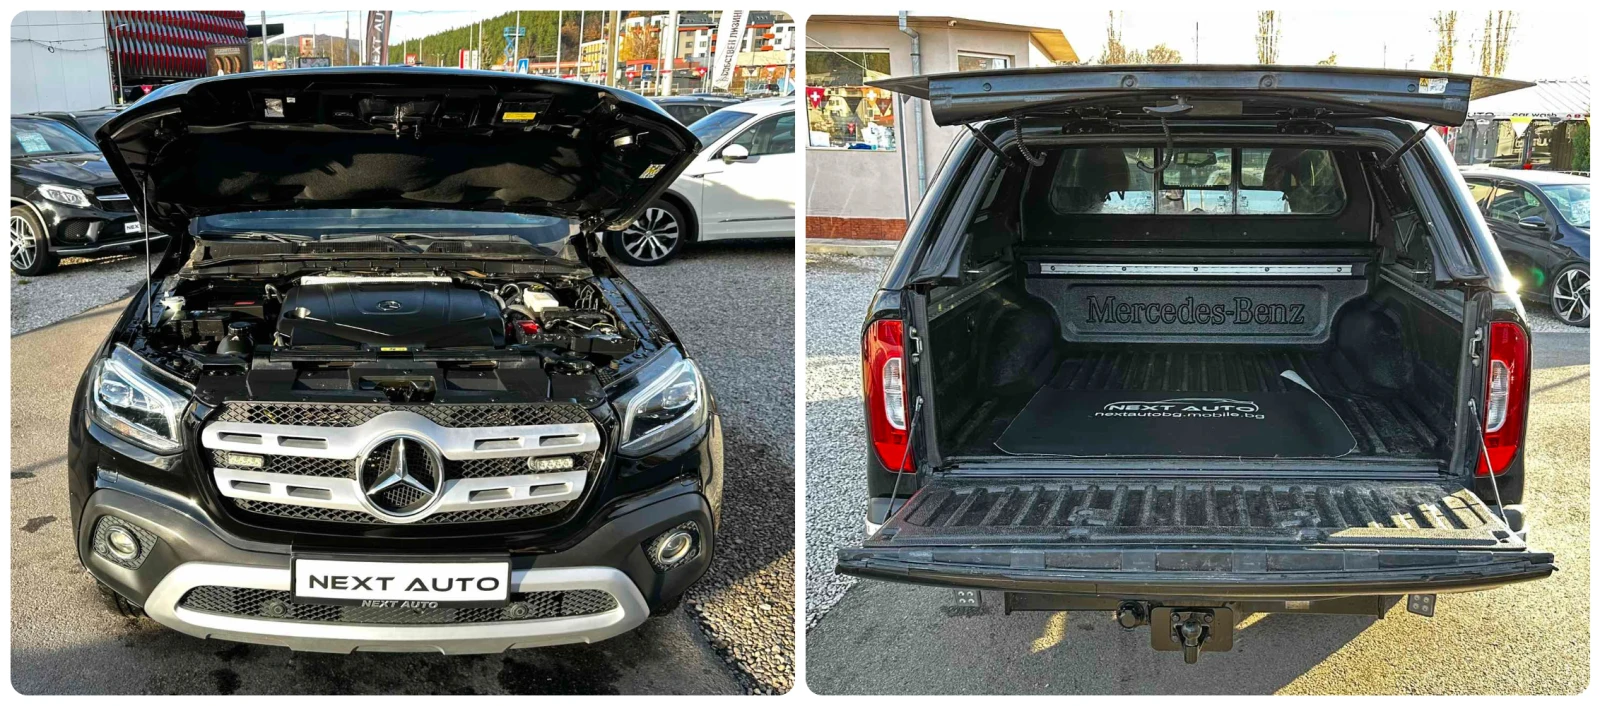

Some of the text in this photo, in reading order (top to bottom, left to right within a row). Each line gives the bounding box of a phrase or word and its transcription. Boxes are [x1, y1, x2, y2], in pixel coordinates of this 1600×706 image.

[374, 10, 385, 33] AU
[1086, 295, 1305, 325] Mercedes-Benz
[1095, 411, 1265, 419] nextautobg.mobile.bg
[309, 574, 500, 592] NEXT AUTO
[361, 599, 438, 609] NEXT AUTO
